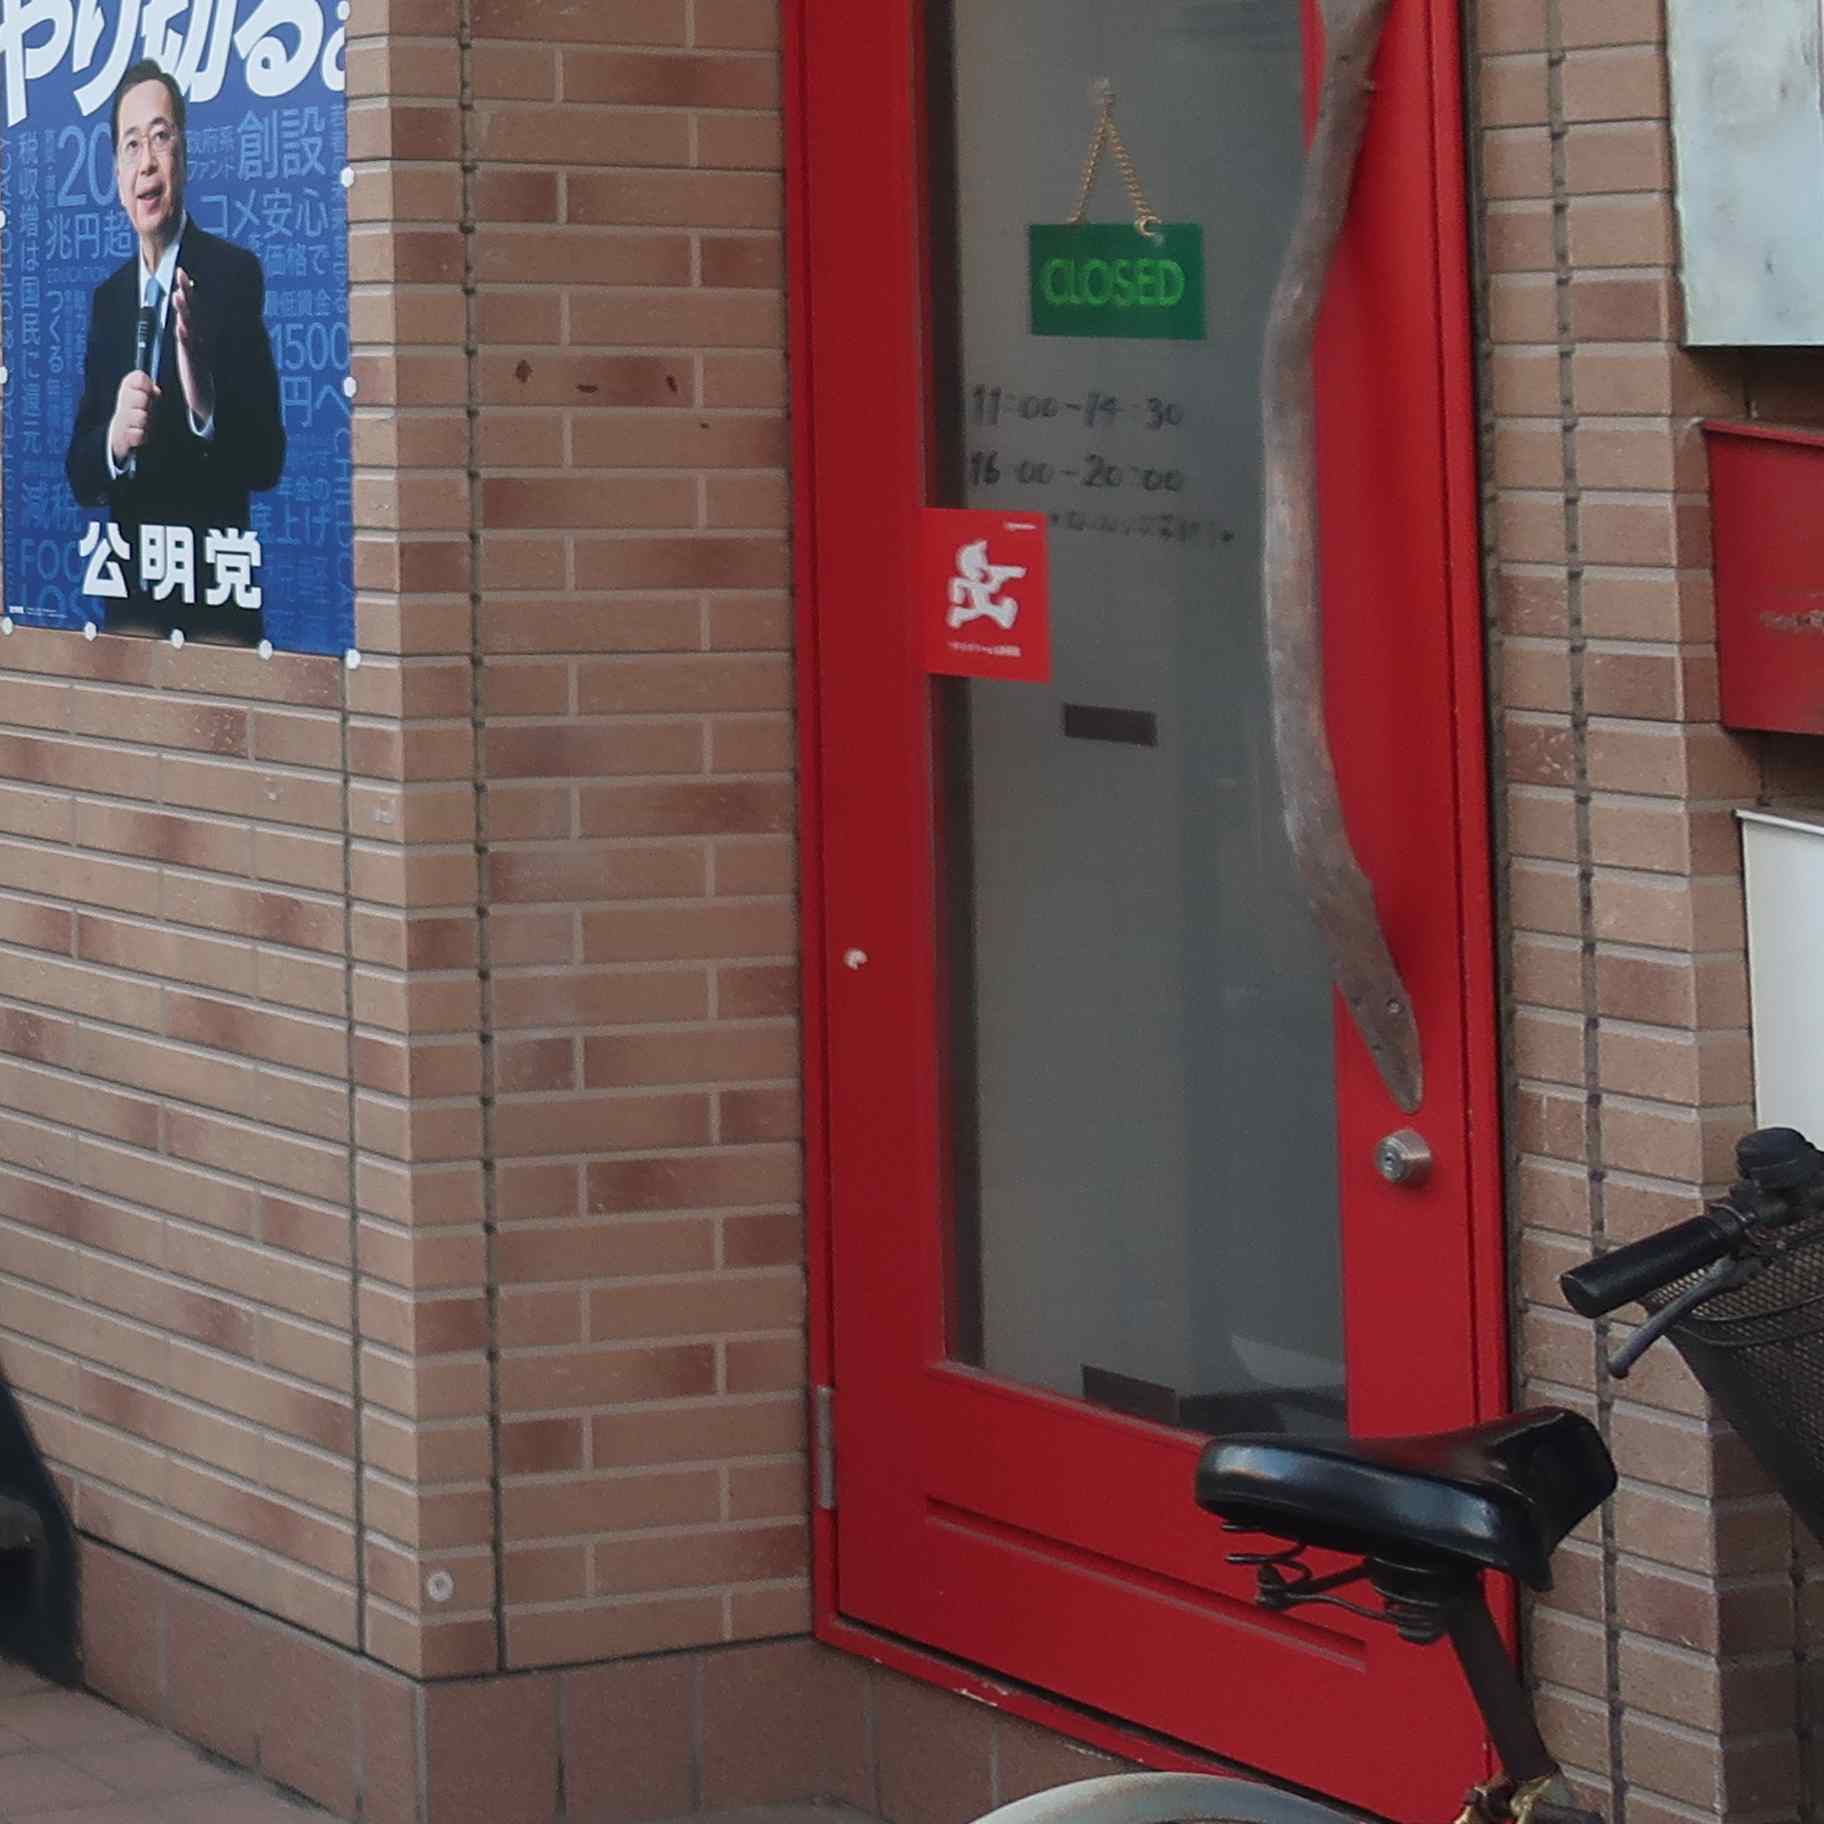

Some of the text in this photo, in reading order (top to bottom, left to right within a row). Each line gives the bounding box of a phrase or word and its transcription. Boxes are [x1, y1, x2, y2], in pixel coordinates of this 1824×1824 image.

[237, 106, 326, 181] 創設
[1044, 257, 1186, 308] CLOSED
[270, 322, 350, 369] 1500
[79, 521, 262, 609] 公明党
